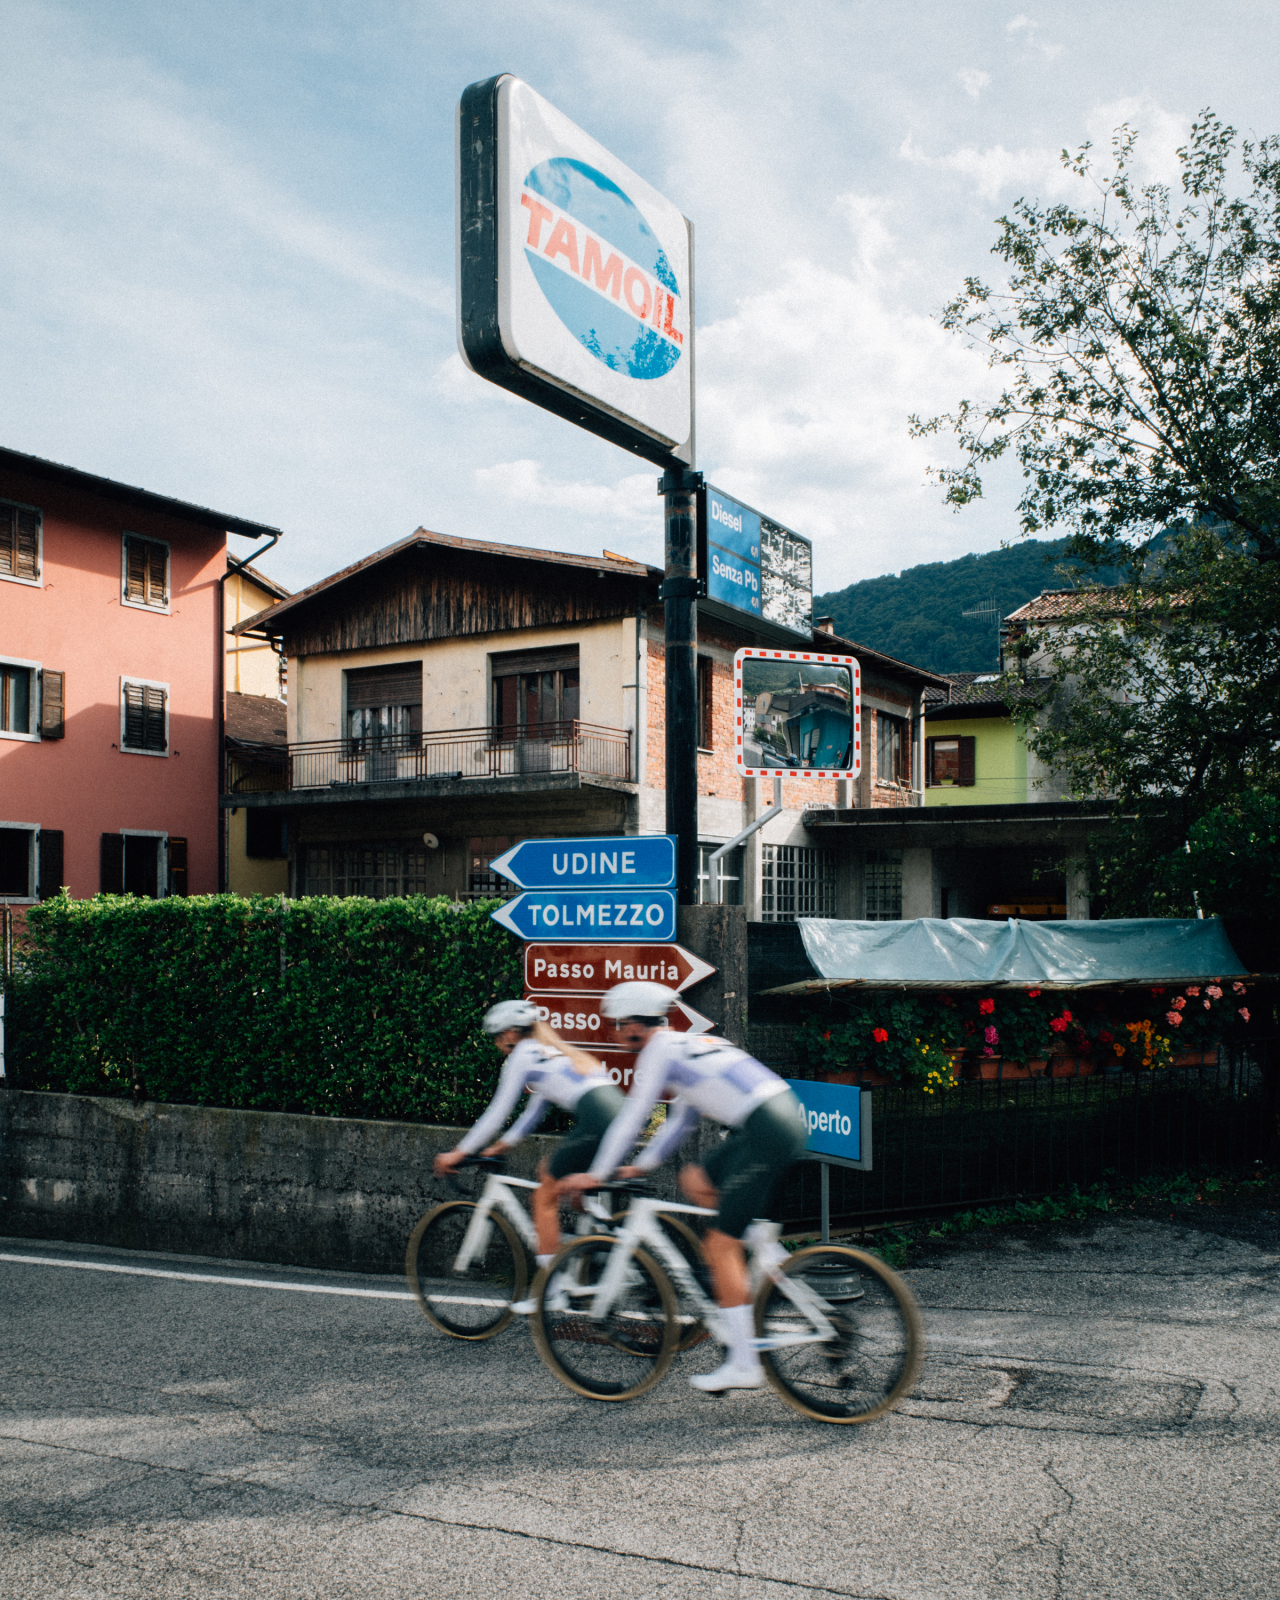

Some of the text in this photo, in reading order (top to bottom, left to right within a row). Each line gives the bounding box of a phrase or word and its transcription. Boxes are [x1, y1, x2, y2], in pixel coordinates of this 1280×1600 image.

[521, 193, 683, 345] TAMOIL
[711, 500, 742, 533] Diesel
[712, 555, 758, 592] Senza Pb
[552, 851, 636, 875] UDINE
[528, 904, 664, 926] TOLMEZZO
[534, 958, 679, 980] Passo Mauria
[536, 1006, 601, 1030] Passo
[798, 1102, 851, 1136] Aperto
